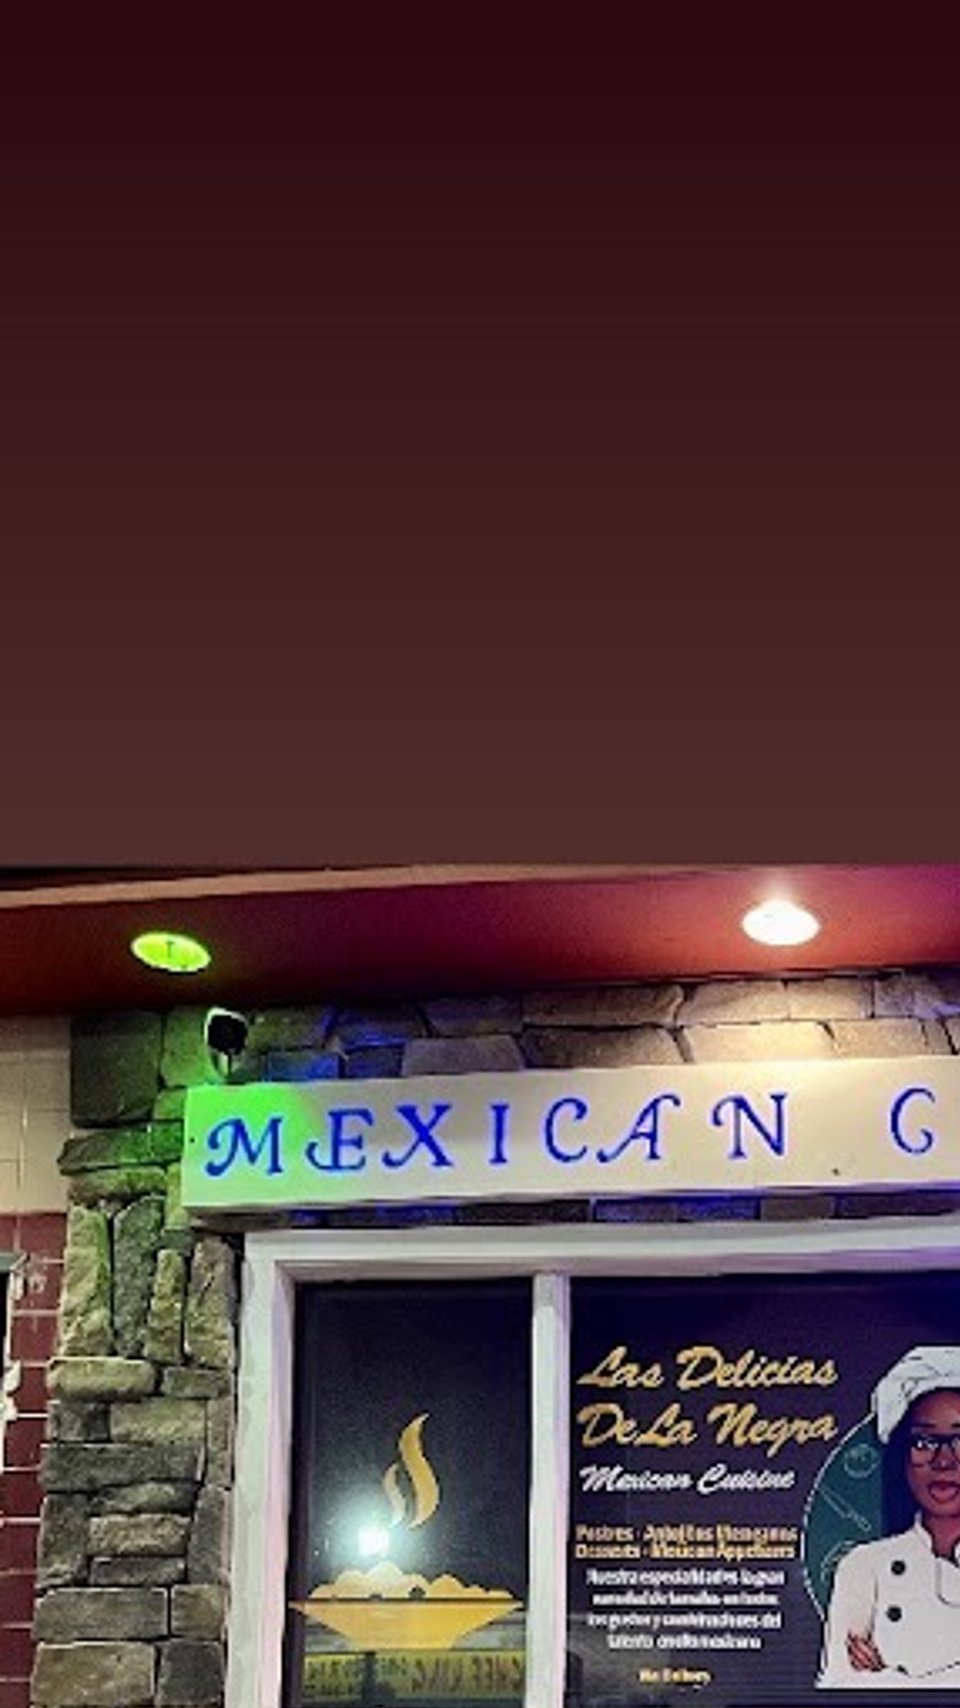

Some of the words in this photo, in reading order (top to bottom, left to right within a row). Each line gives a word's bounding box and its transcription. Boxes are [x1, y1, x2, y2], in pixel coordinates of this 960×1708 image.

[204, 1093, 789, 1176] MEXICAN
[576, 1346, 664, 1388] Las
[675, 1345, 838, 1390] Delicias
[707, 1402, 838, 1457] Negra
[579, 1464, 692, 1491] Mexican
[697, 1463, 795, 1494] Cuisine
